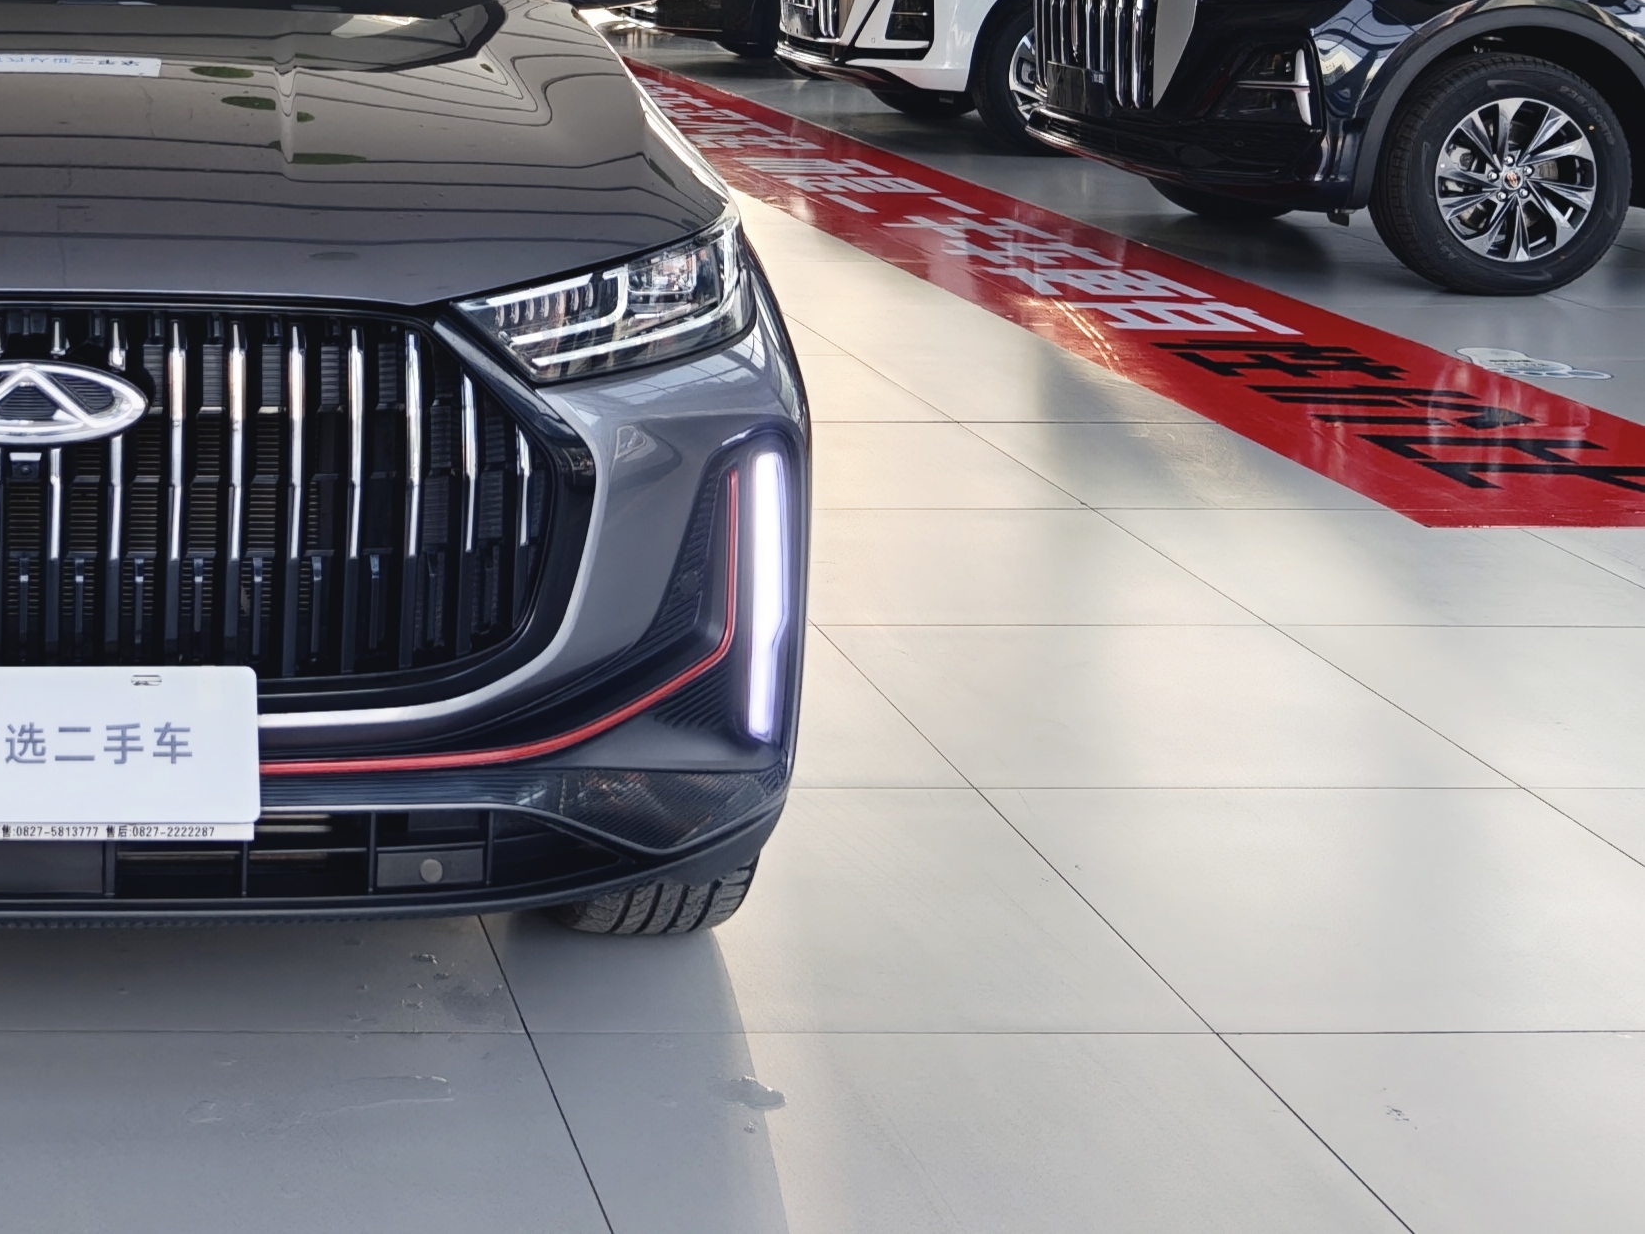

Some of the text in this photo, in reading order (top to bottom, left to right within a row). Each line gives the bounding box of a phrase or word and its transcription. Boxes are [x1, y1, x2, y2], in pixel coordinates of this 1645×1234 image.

[634, 76, 826, 150] 新车买不起
[105, 824, 216, 839] 售后:0827-2222287
